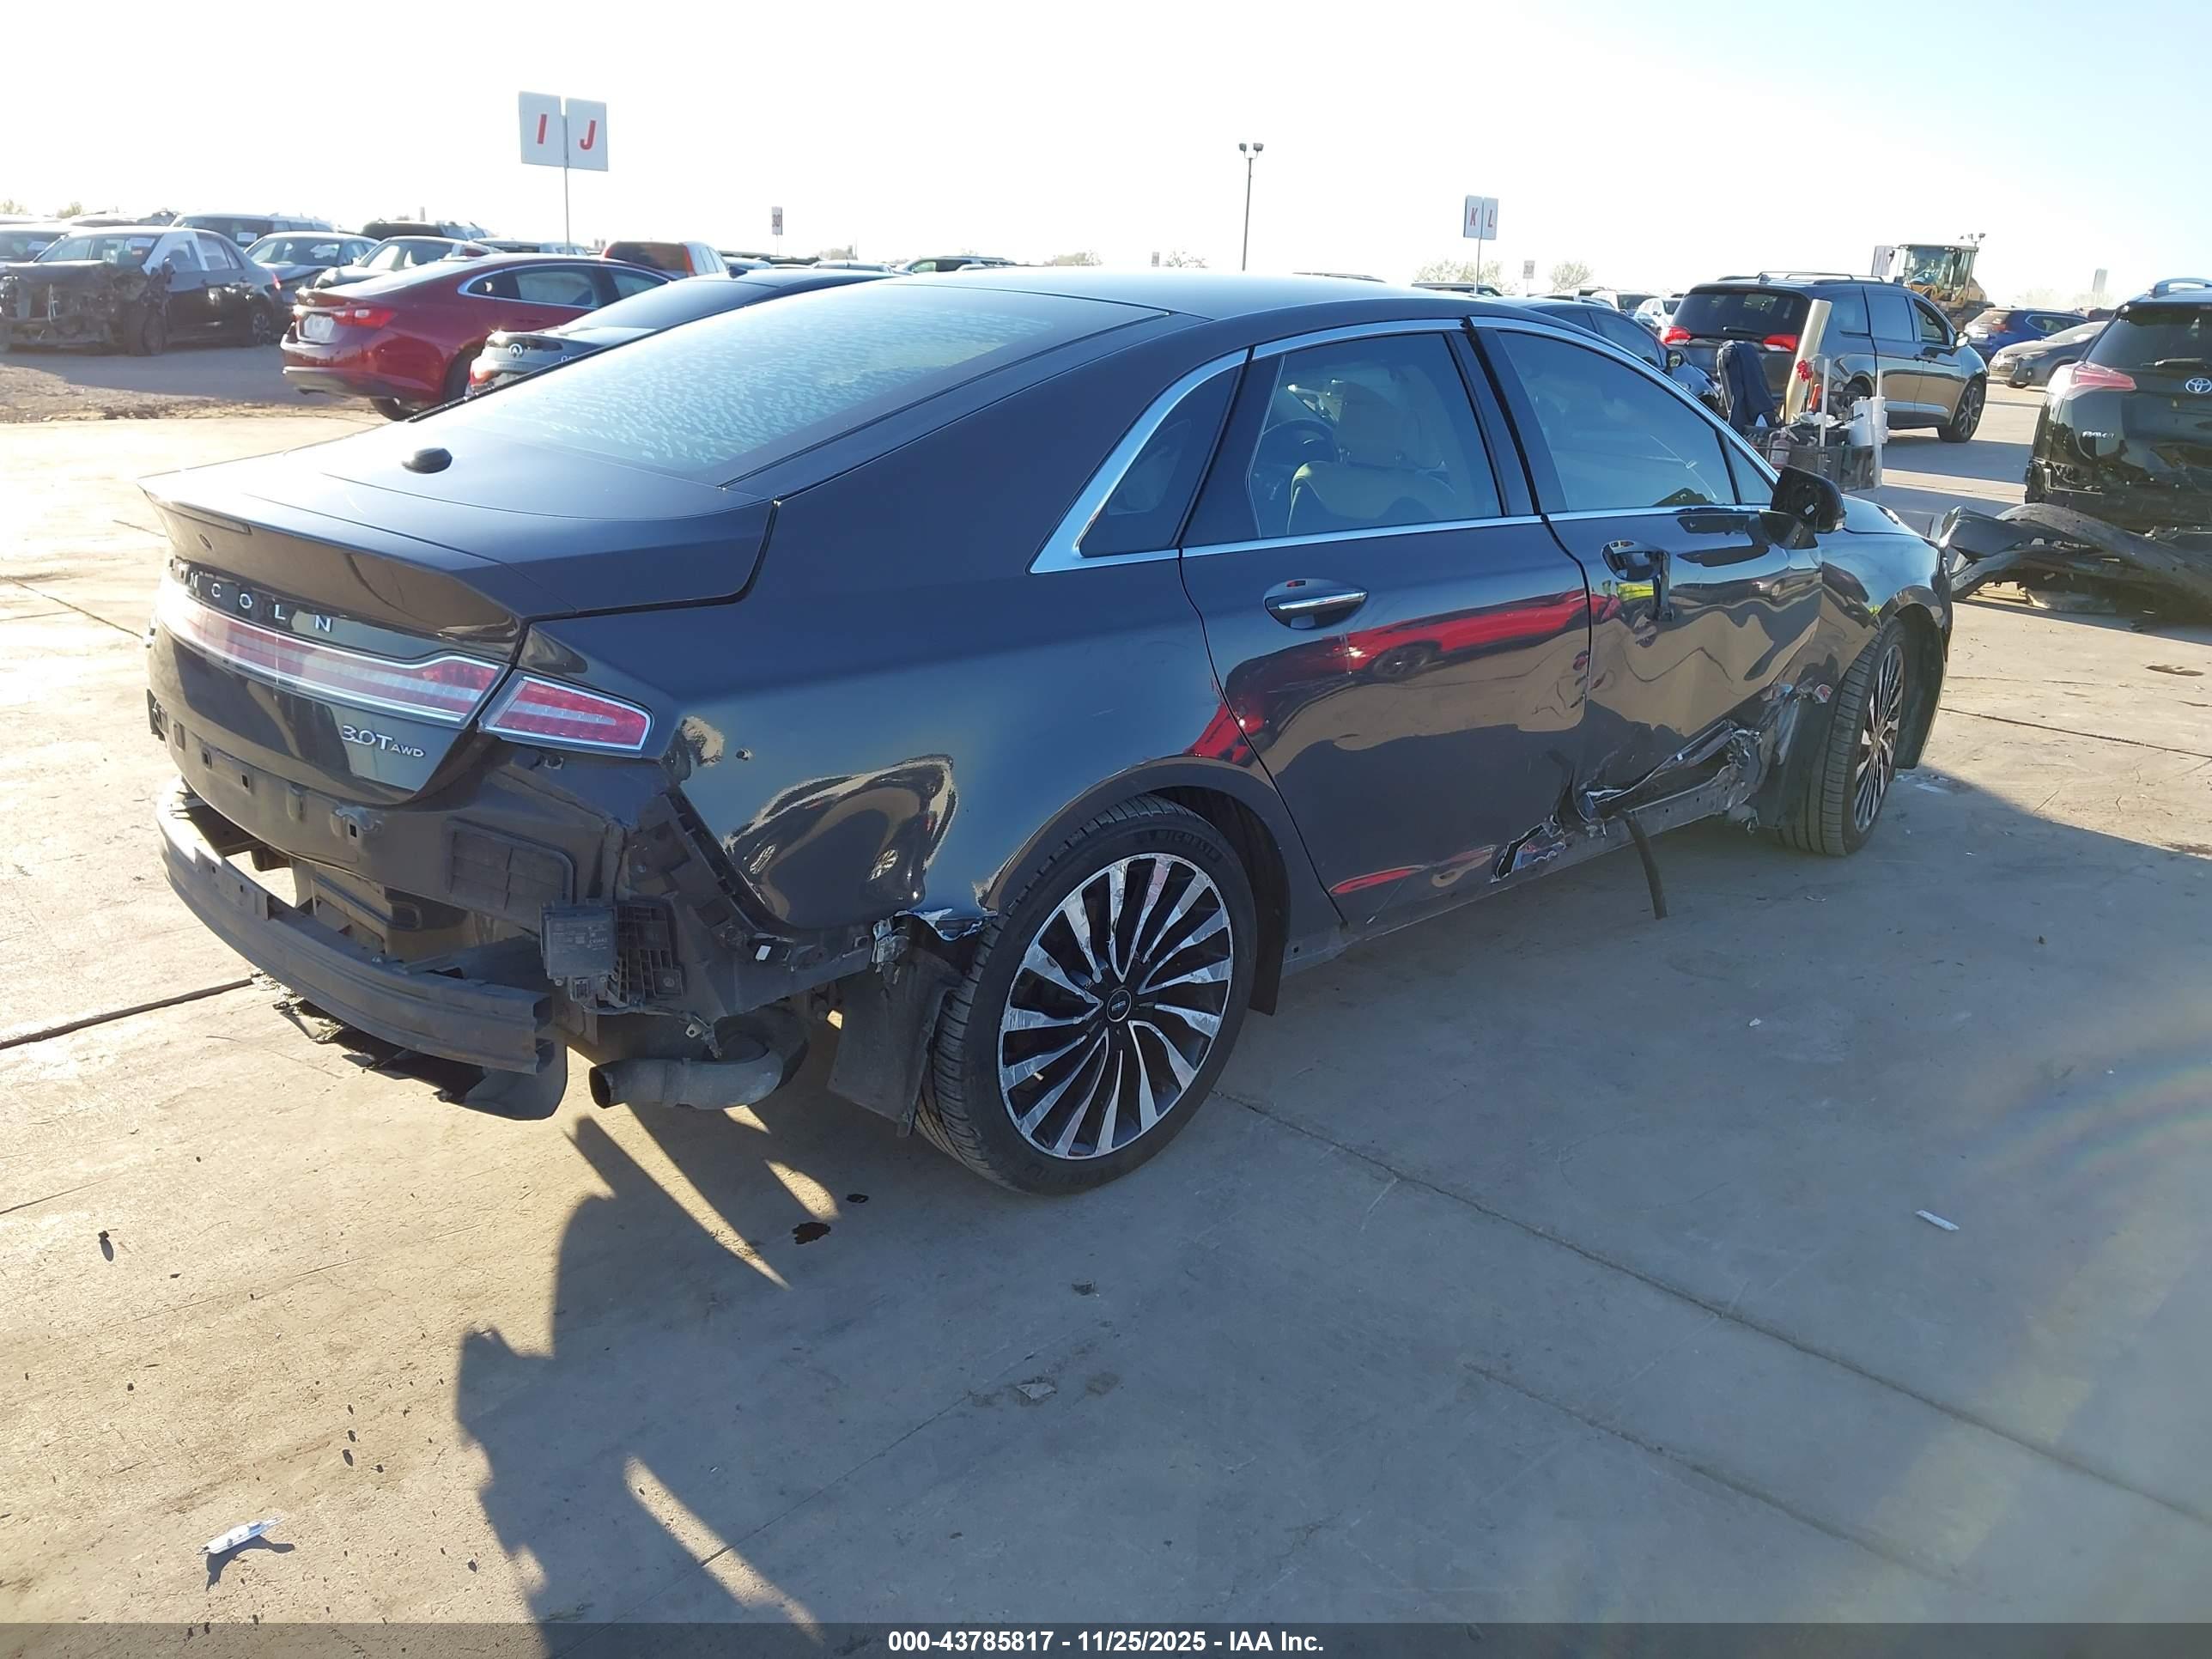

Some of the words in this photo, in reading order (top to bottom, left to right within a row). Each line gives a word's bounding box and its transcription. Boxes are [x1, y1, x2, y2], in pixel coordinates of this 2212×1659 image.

[537, 113, 548, 144] I
[579, 119, 597, 150] J
[1469, 206, 1479, 227] K
[1487, 209, 1493, 228] L
[391, 743, 425, 757] AWD
